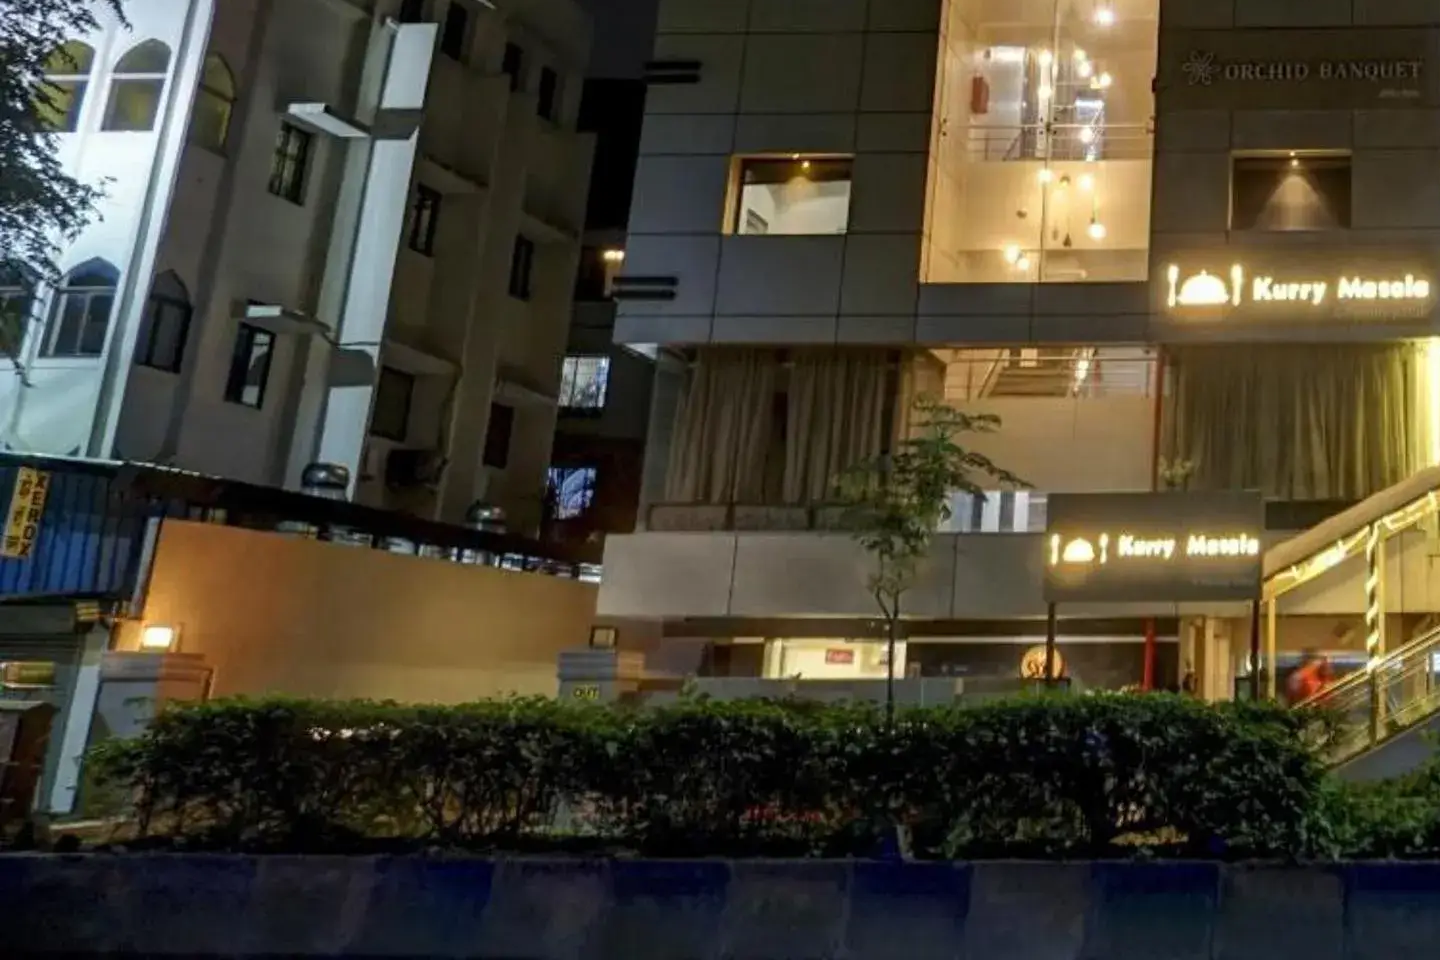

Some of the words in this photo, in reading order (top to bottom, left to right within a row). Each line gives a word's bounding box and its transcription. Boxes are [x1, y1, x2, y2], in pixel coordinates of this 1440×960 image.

[1225, 62, 1310, 81] ORCHID
[1319, 60, 1423, 82] BANQUET
[1252, 276, 1327, 305] Kurry
[1337, 274, 1430, 300] Masala
[1117, 534, 1176, 560] Kurry
[1186, 532, 1260, 556] Masala
